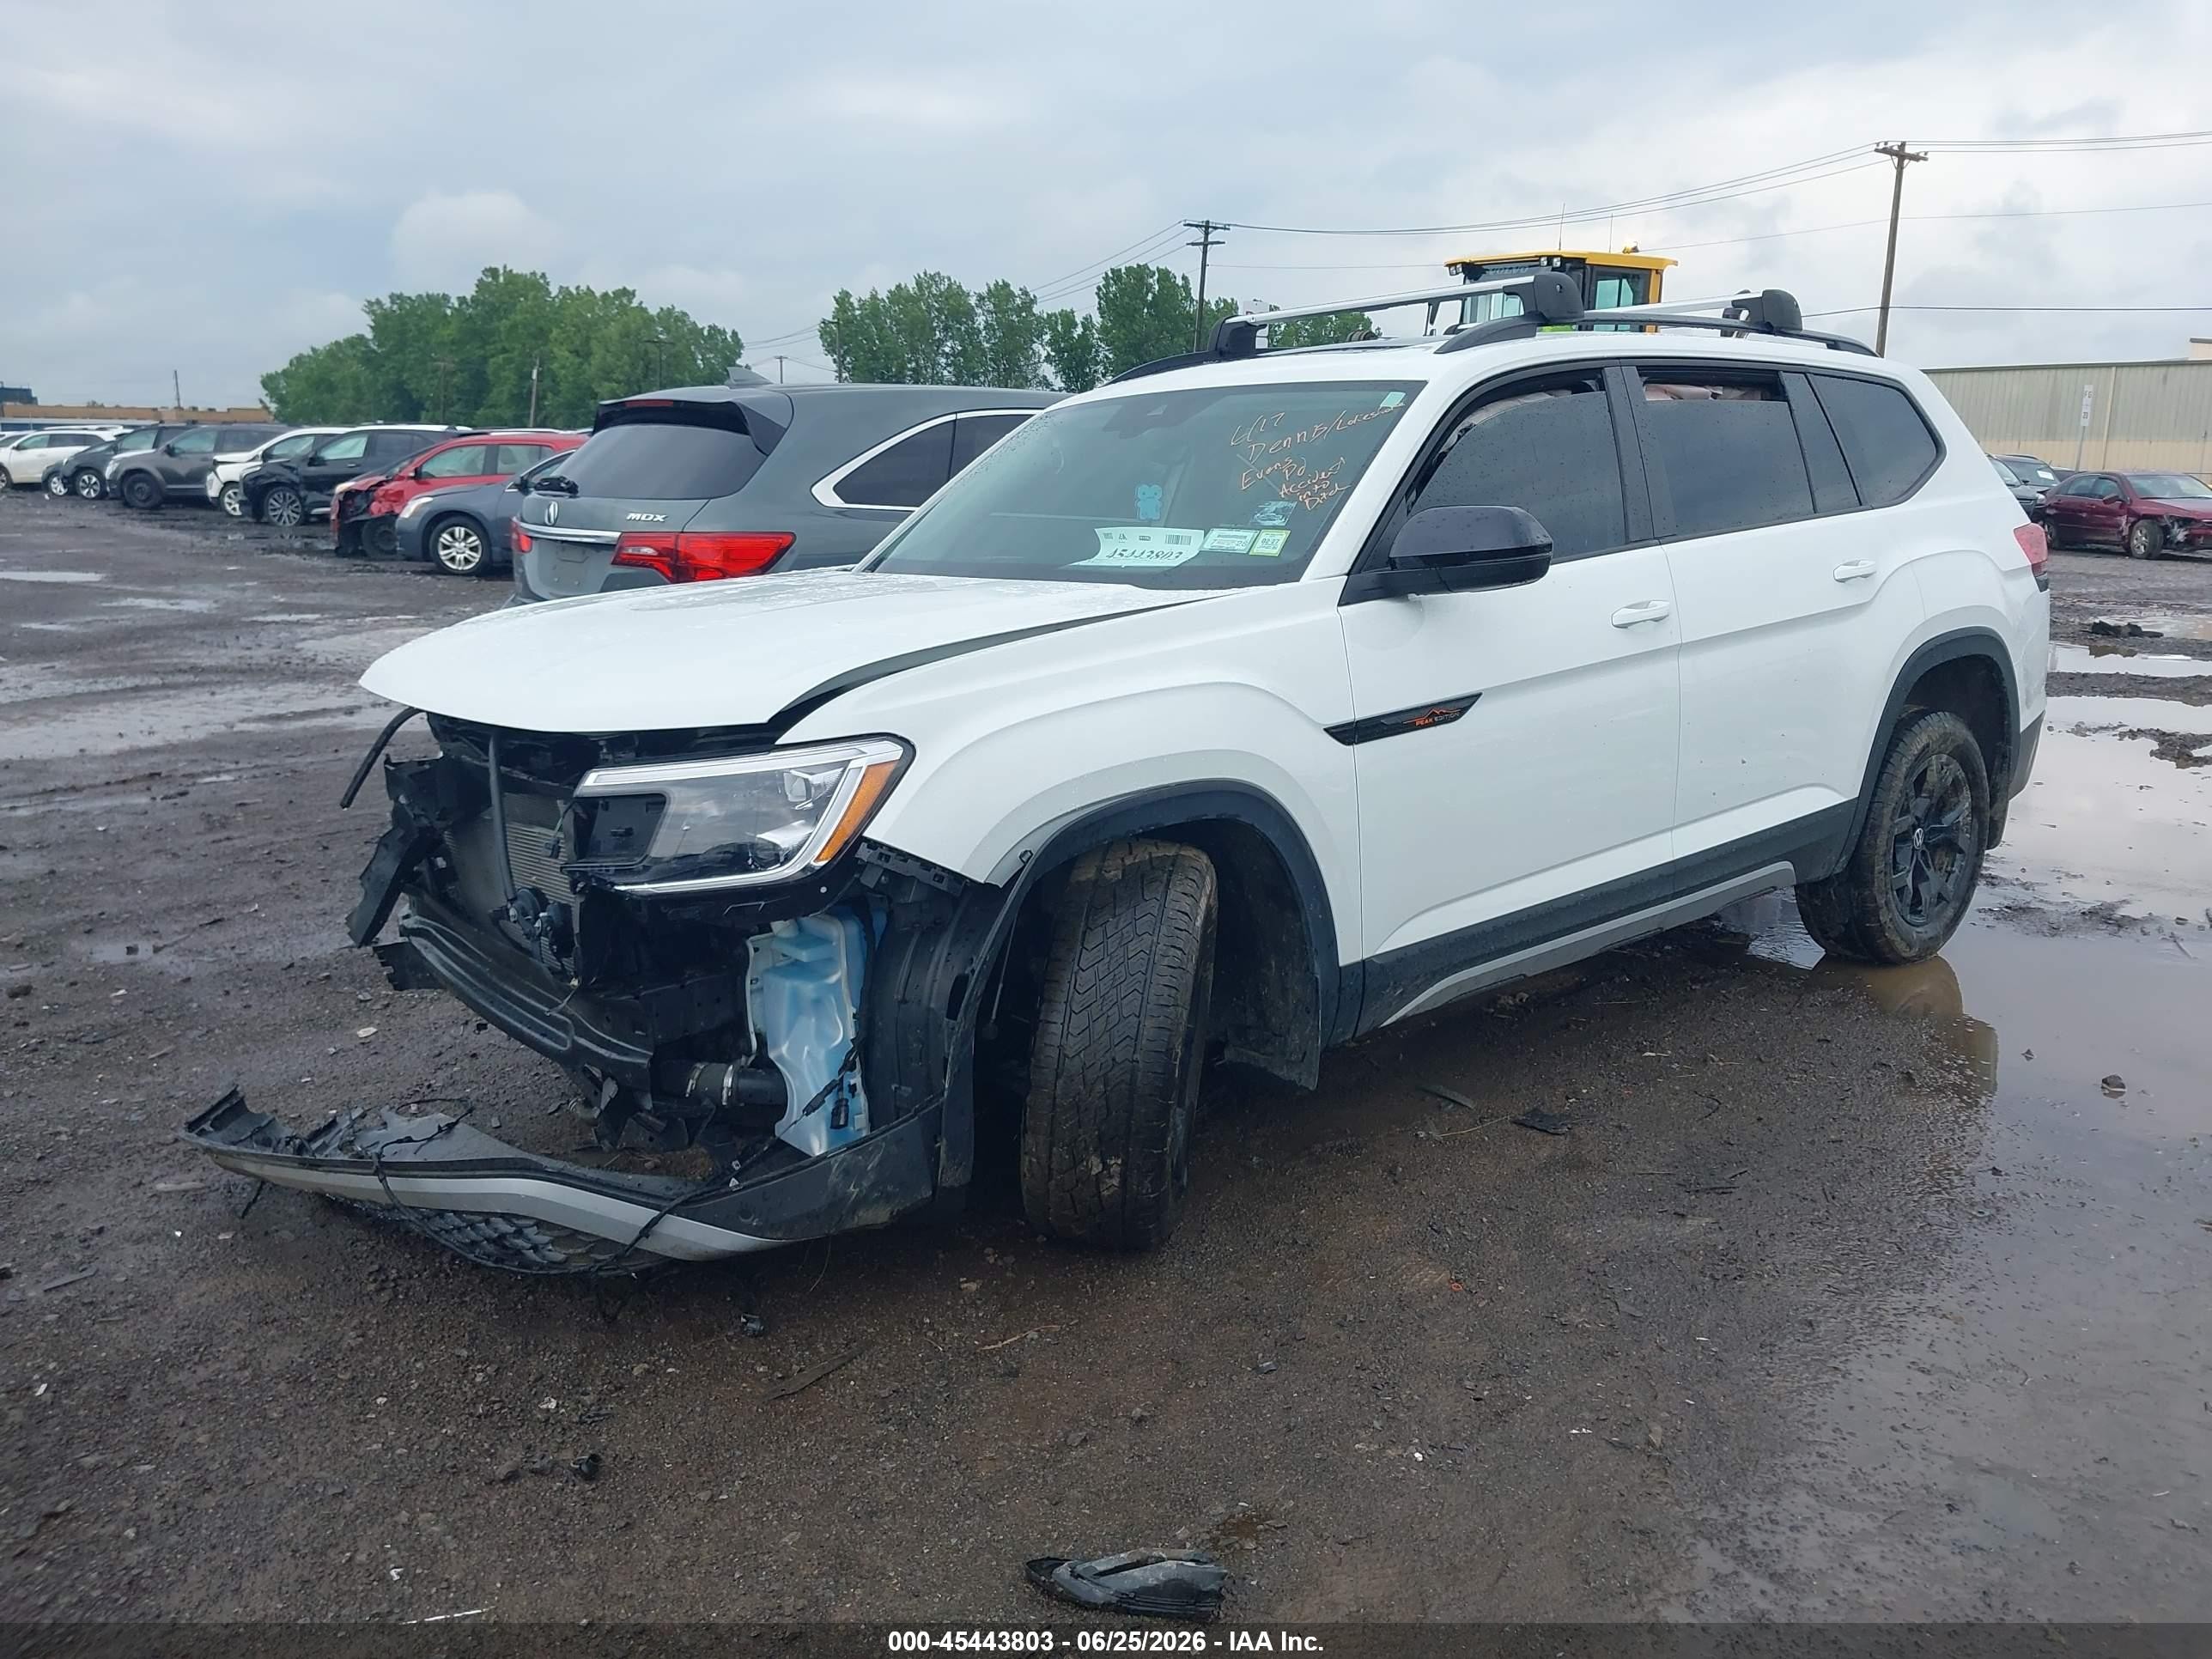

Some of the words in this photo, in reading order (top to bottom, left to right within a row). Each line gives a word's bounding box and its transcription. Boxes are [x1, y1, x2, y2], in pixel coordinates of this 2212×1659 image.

[626, 512, 668, 523] MDX
[1415, 716, 1434, 727] PEAK
[1434, 712, 1461, 723] EDITION
